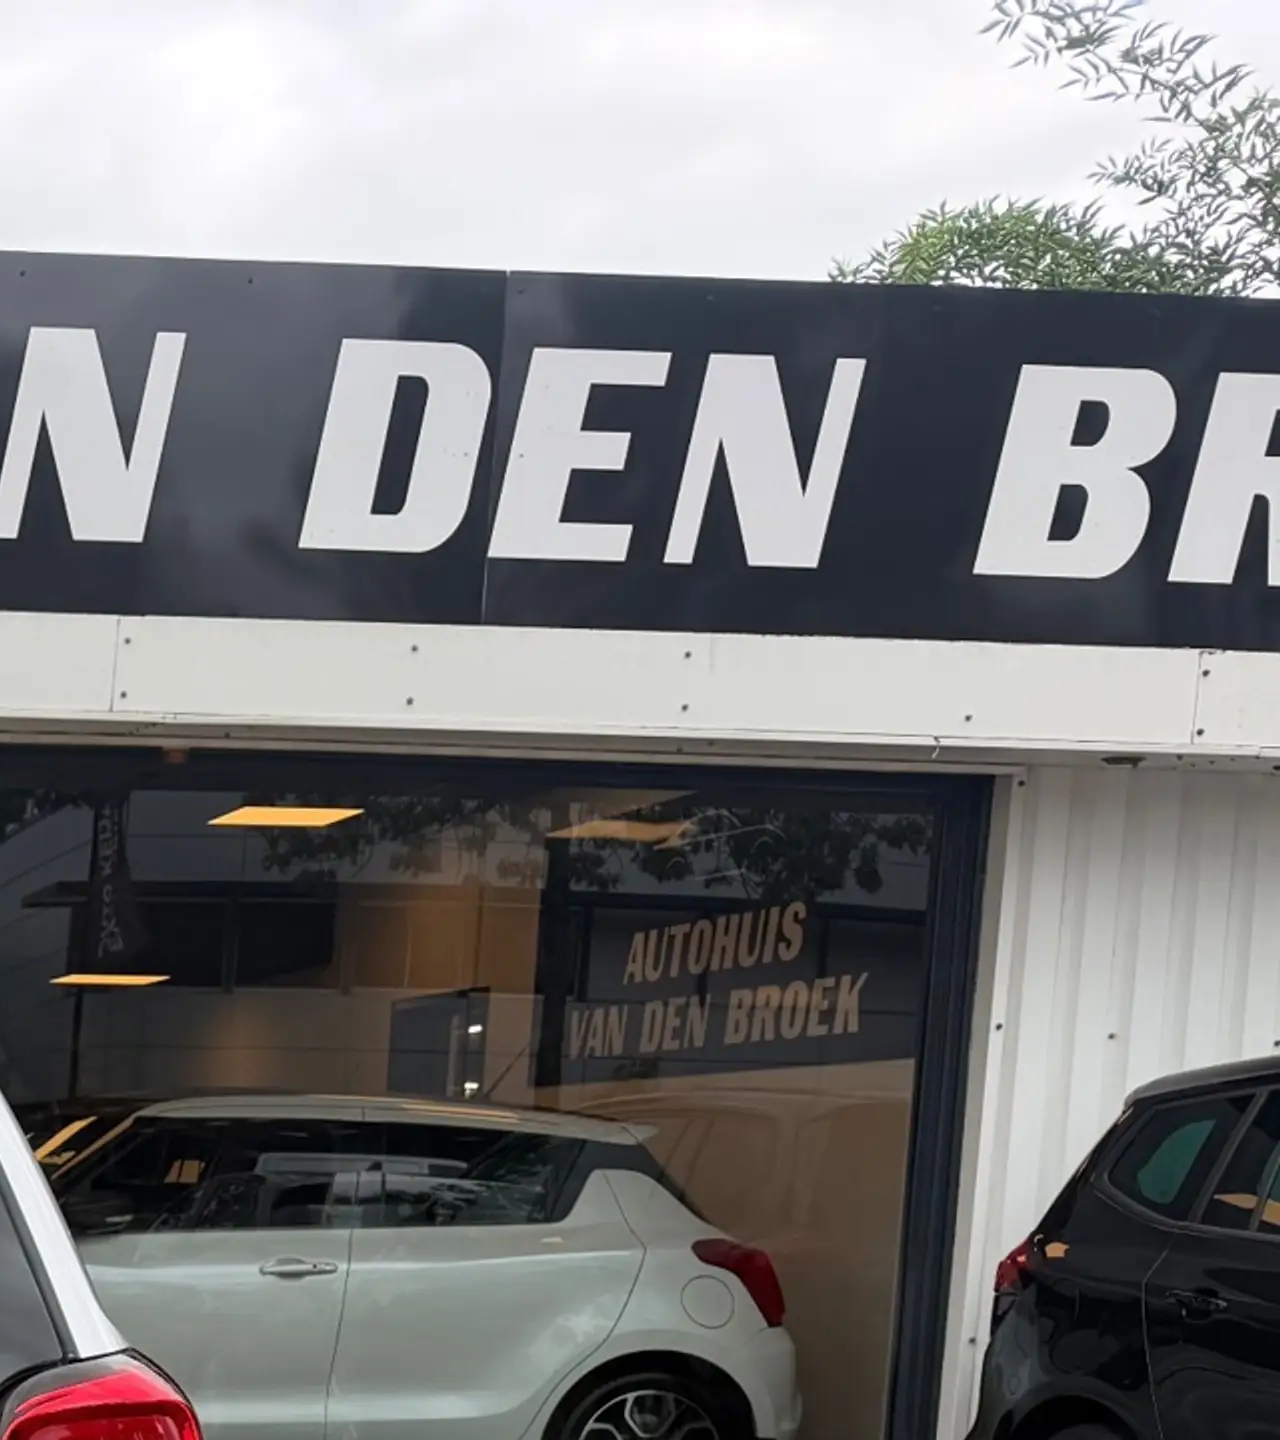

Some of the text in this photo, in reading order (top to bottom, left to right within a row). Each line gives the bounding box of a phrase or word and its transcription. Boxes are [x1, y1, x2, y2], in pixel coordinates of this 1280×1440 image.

[298, 338, 867, 569] DEN
[622, 901, 807, 985] AUTOHUIS
[569, 972, 869, 1060] VAN DEN BROEK
